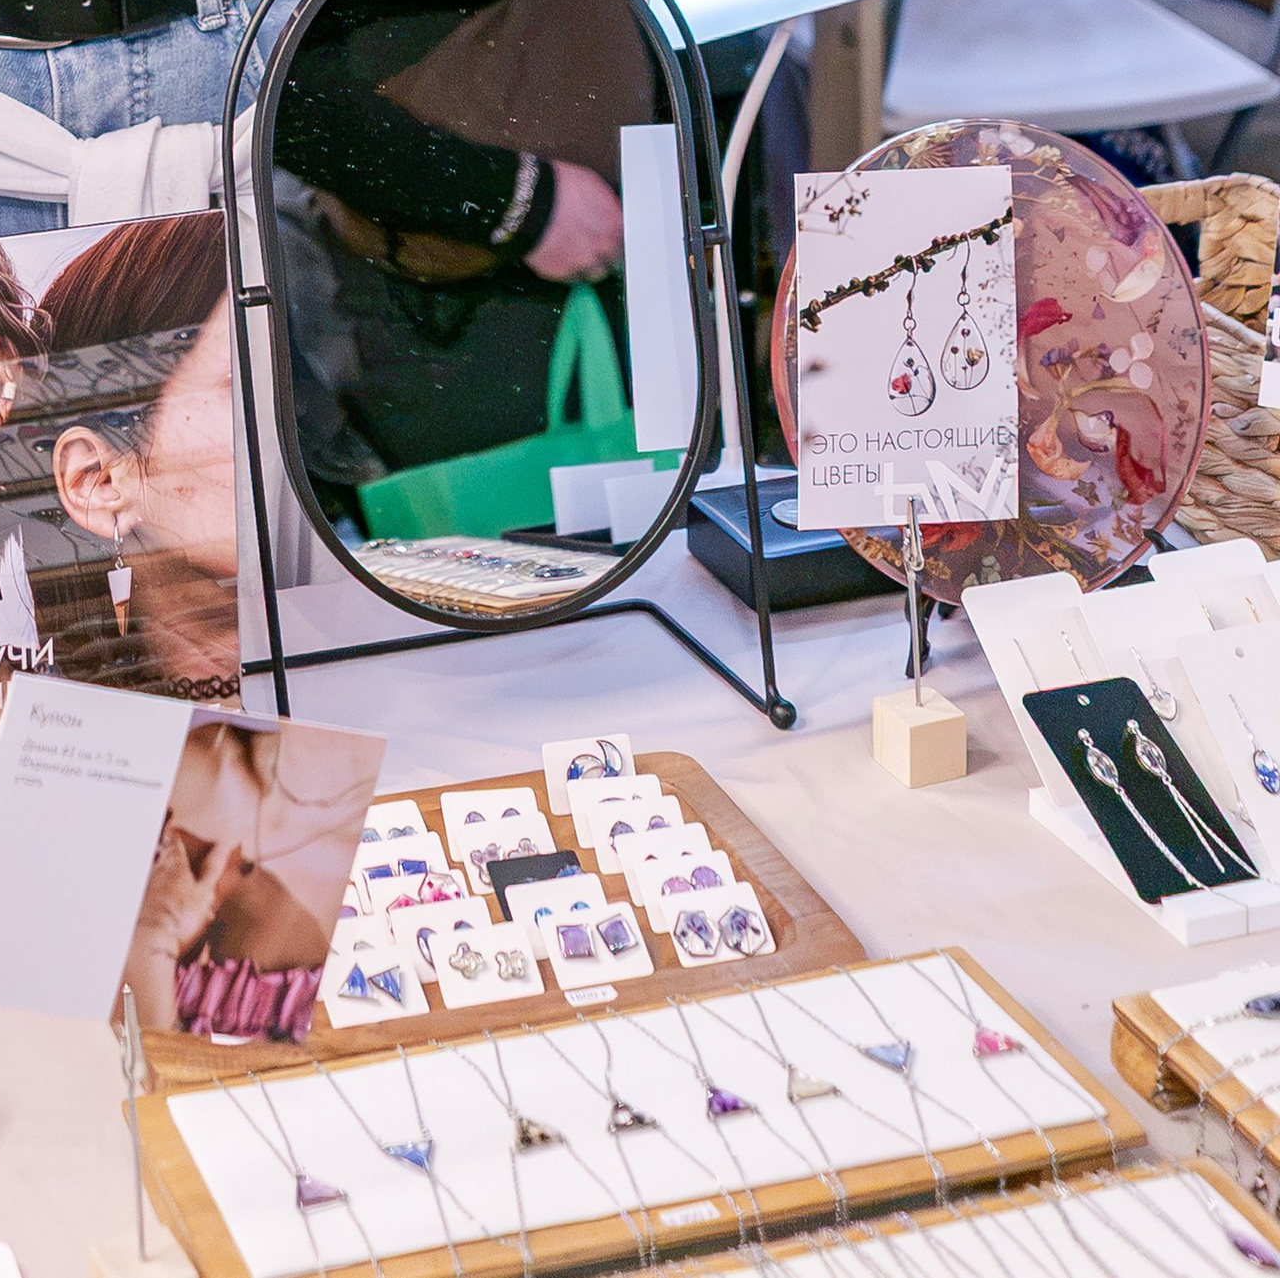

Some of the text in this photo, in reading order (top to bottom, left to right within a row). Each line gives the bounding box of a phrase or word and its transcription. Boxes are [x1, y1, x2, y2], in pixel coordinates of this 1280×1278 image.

[811, 426, 1007, 454] ЭТО НАСТОЯЩИЕ
[812, 463, 881, 489] ЦВЕТЫ
